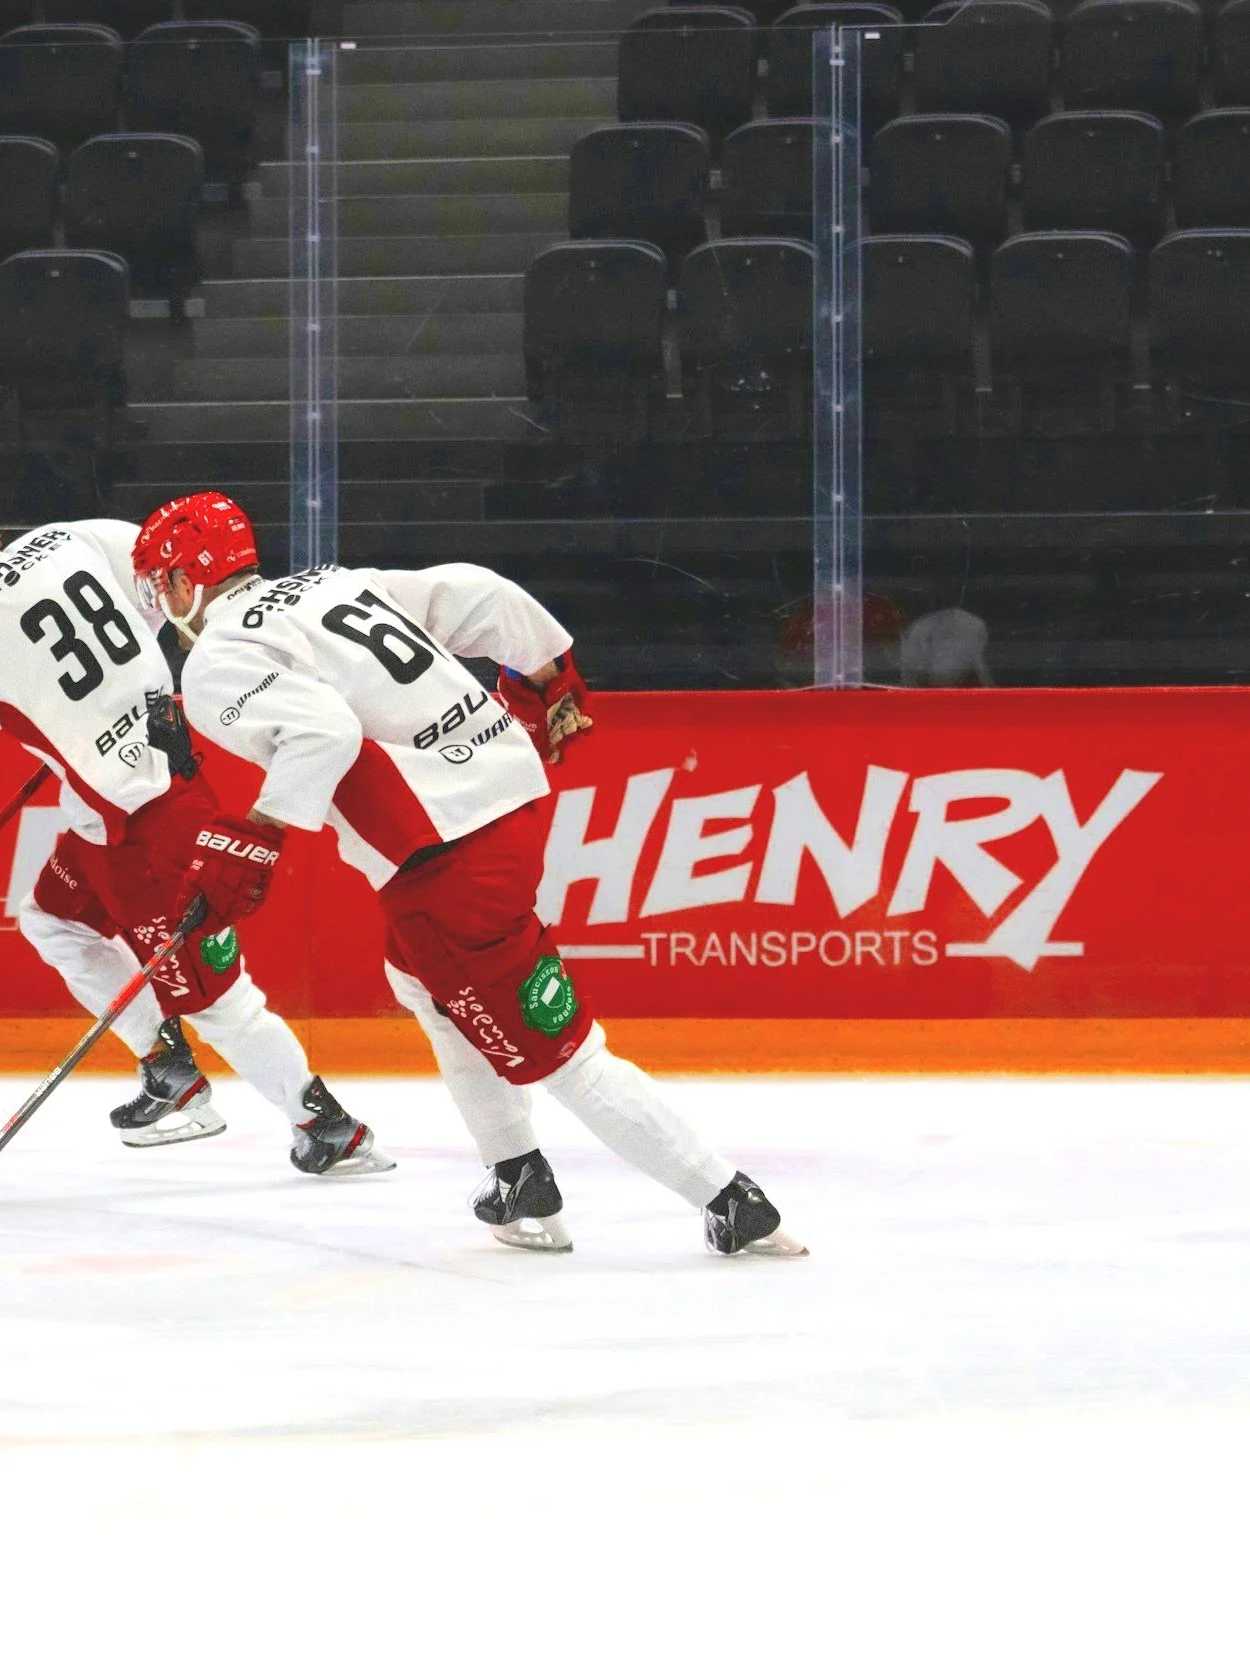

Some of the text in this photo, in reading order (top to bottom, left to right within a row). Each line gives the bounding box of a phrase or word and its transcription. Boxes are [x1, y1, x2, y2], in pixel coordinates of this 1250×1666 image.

[197, 549, 215, 567] 61
[20, 570, 142, 702] 38
[321, 588, 451, 685] 61
[413, 690, 489, 750] BAU
[470, 711, 513, 747] WAR
[195, 830, 280, 867] BAUER
[533, 764, 1164, 972] HENRY
[641, 929, 940, 967] TRANSPORTS
